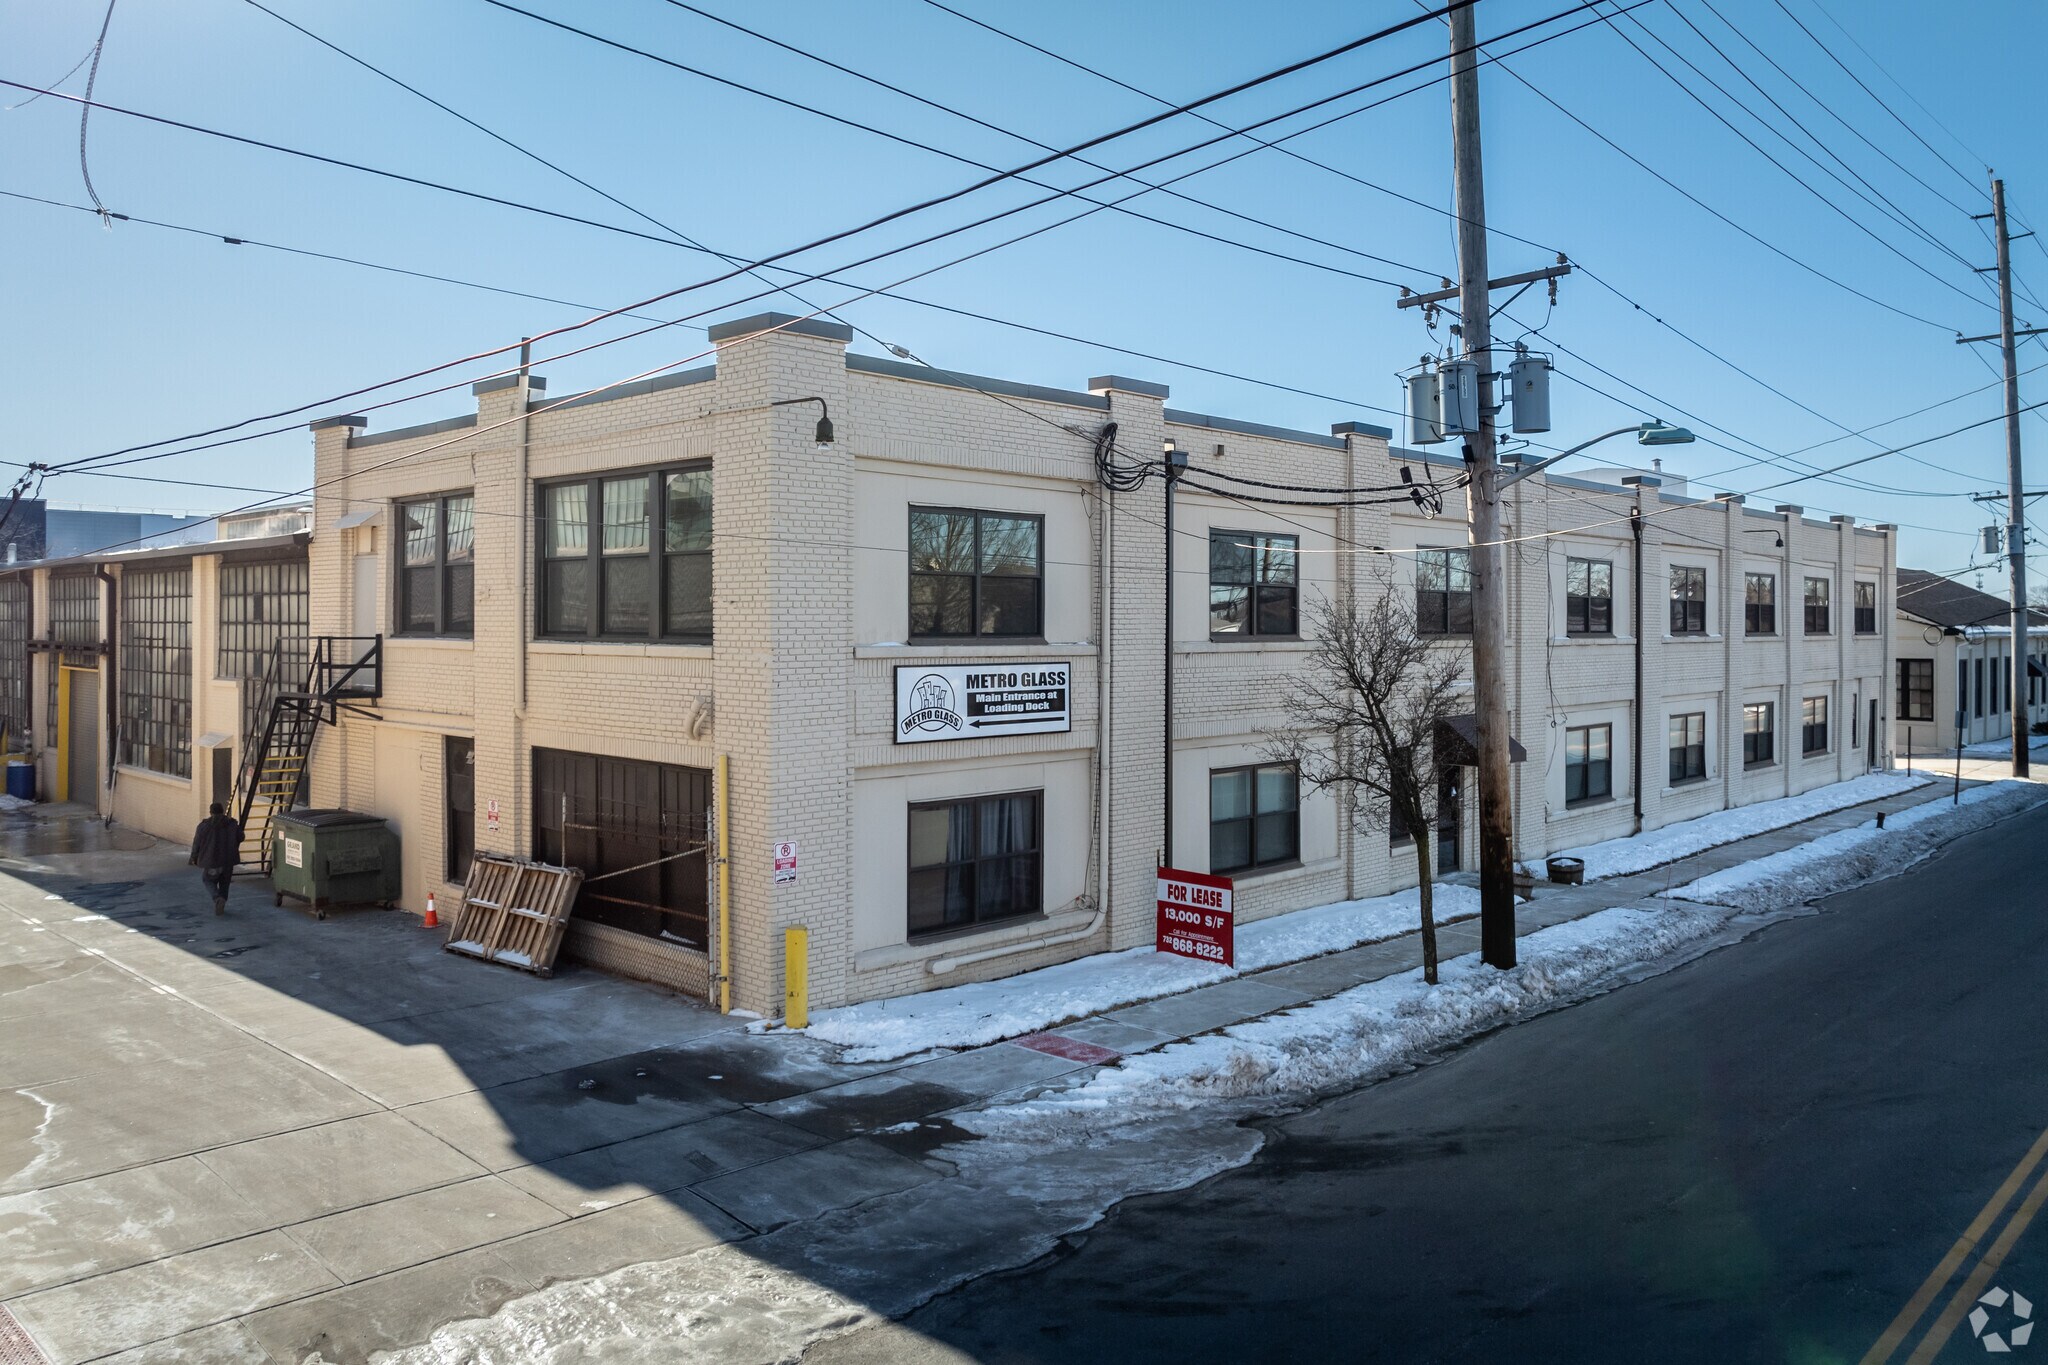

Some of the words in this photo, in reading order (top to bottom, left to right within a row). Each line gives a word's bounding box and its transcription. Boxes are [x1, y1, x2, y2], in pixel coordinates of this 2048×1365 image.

[966, 672, 1017, 689] METRO
[1021, 671, 1066, 687] GLASS
[975, 693, 1001, 703] Main
[1003, 691, 1046, 701] Entrance
[1047, 690, 1058, 700] at
[984, 703, 1024, 714] Loading
[1026, 701, 1050, 711] Dock
[904, 710, 933, 731] METRO
[934, 709, 960, 727] GLASS
[1168, 884, 1187, 902] FOR
[1192, 888, 1222, 908] LEASE
[1165, 908, 1200, 924] 13,000
[1204, 916, 1224, 928] S/F
[1172, 938, 1224, 960] 868-8222
